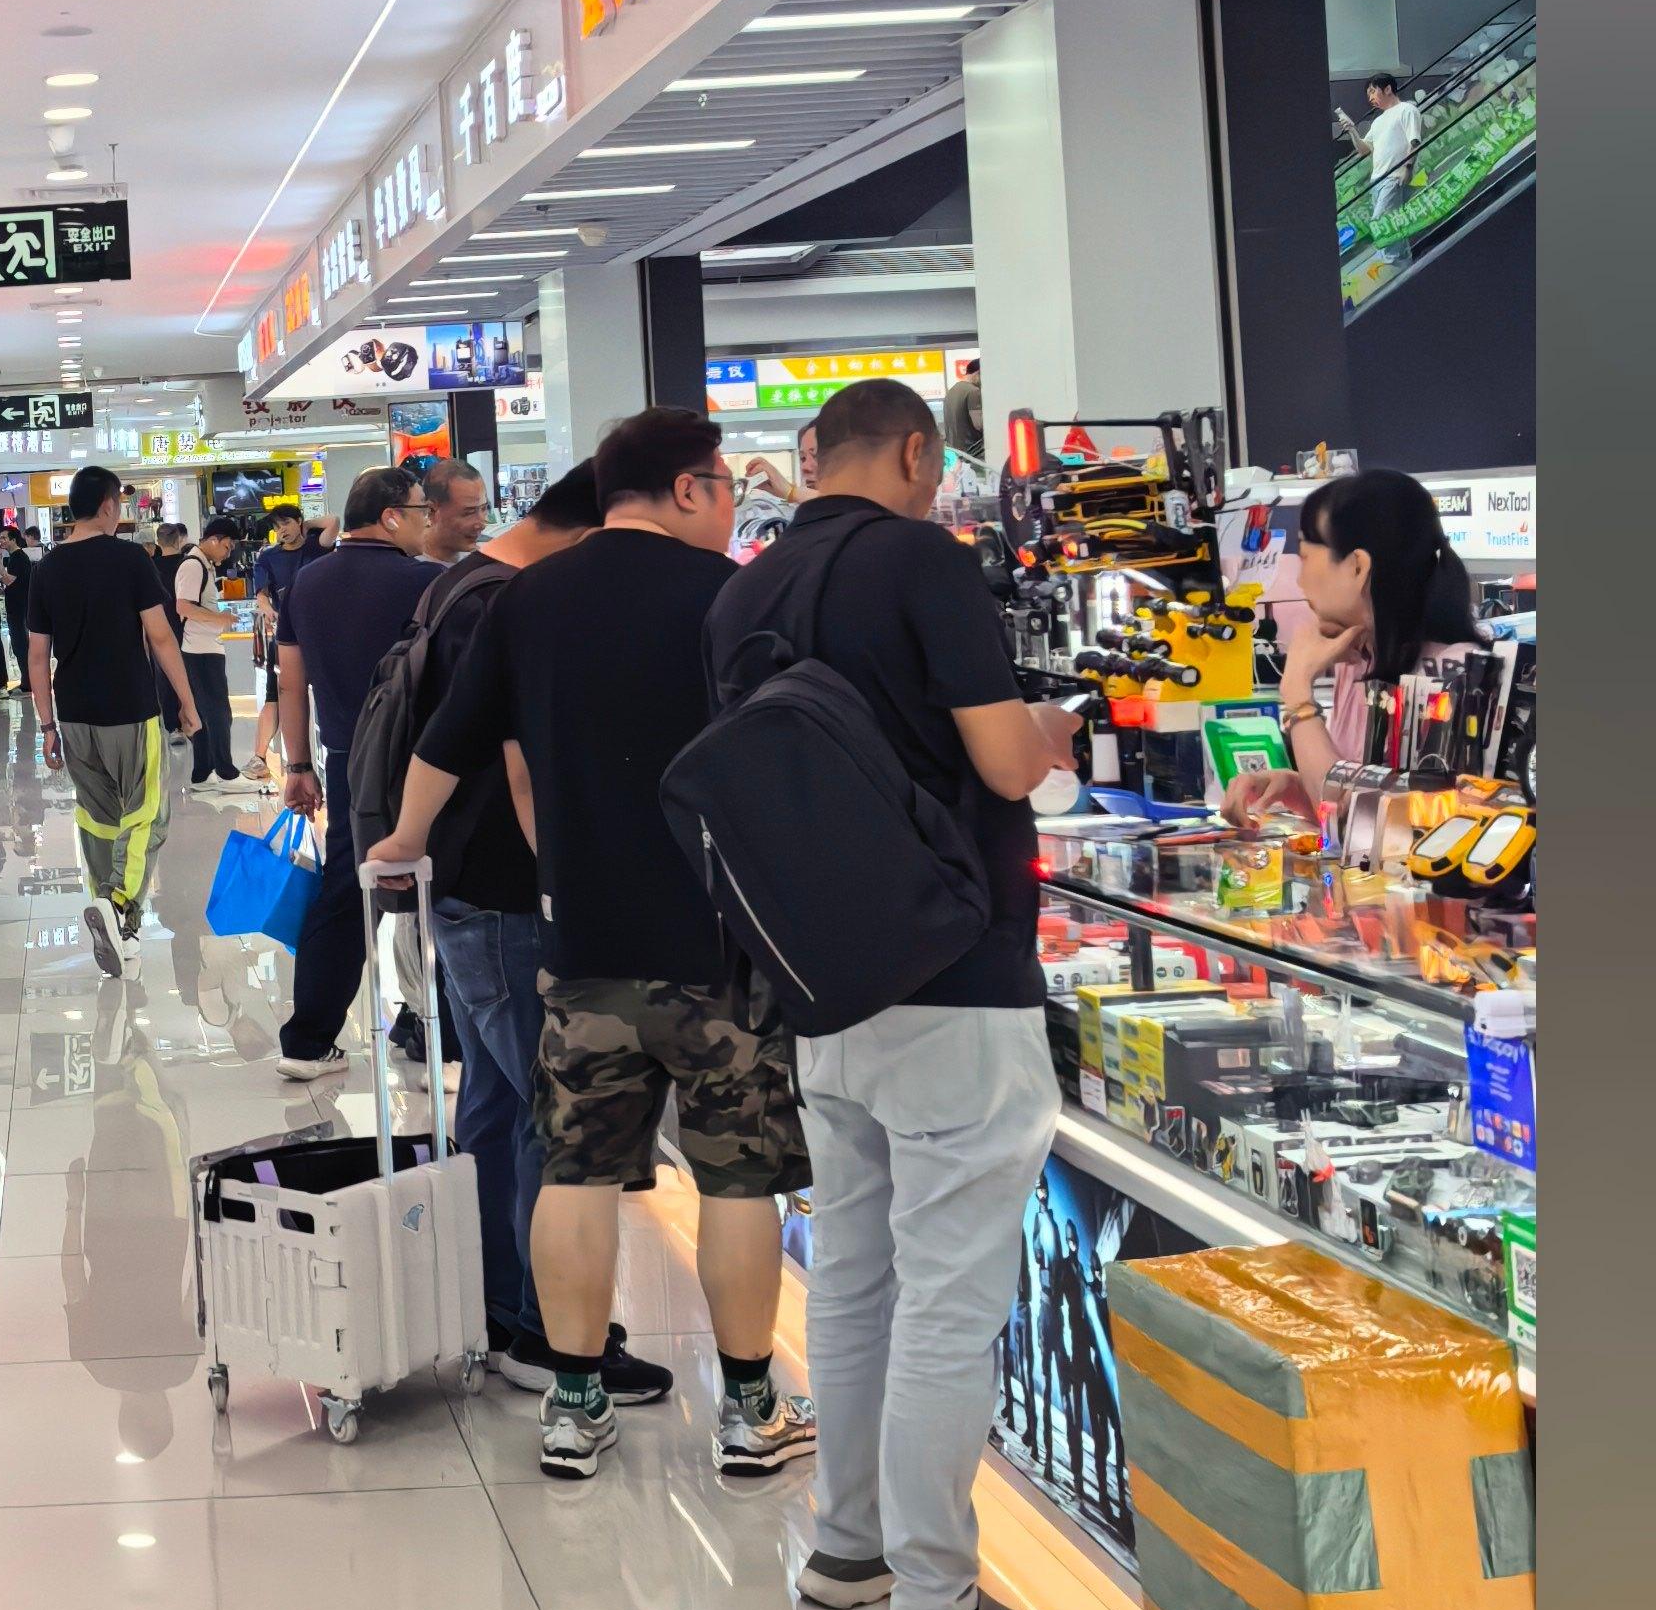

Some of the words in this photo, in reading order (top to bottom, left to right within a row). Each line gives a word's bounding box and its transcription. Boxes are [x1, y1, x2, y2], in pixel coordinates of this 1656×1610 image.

[67, 225, 116, 244] 安全出口
[73, 241, 113, 253] EXIT
[1488, 492, 1531, 511] NexTool
[1487, 531, 1529, 547] TrustFire
